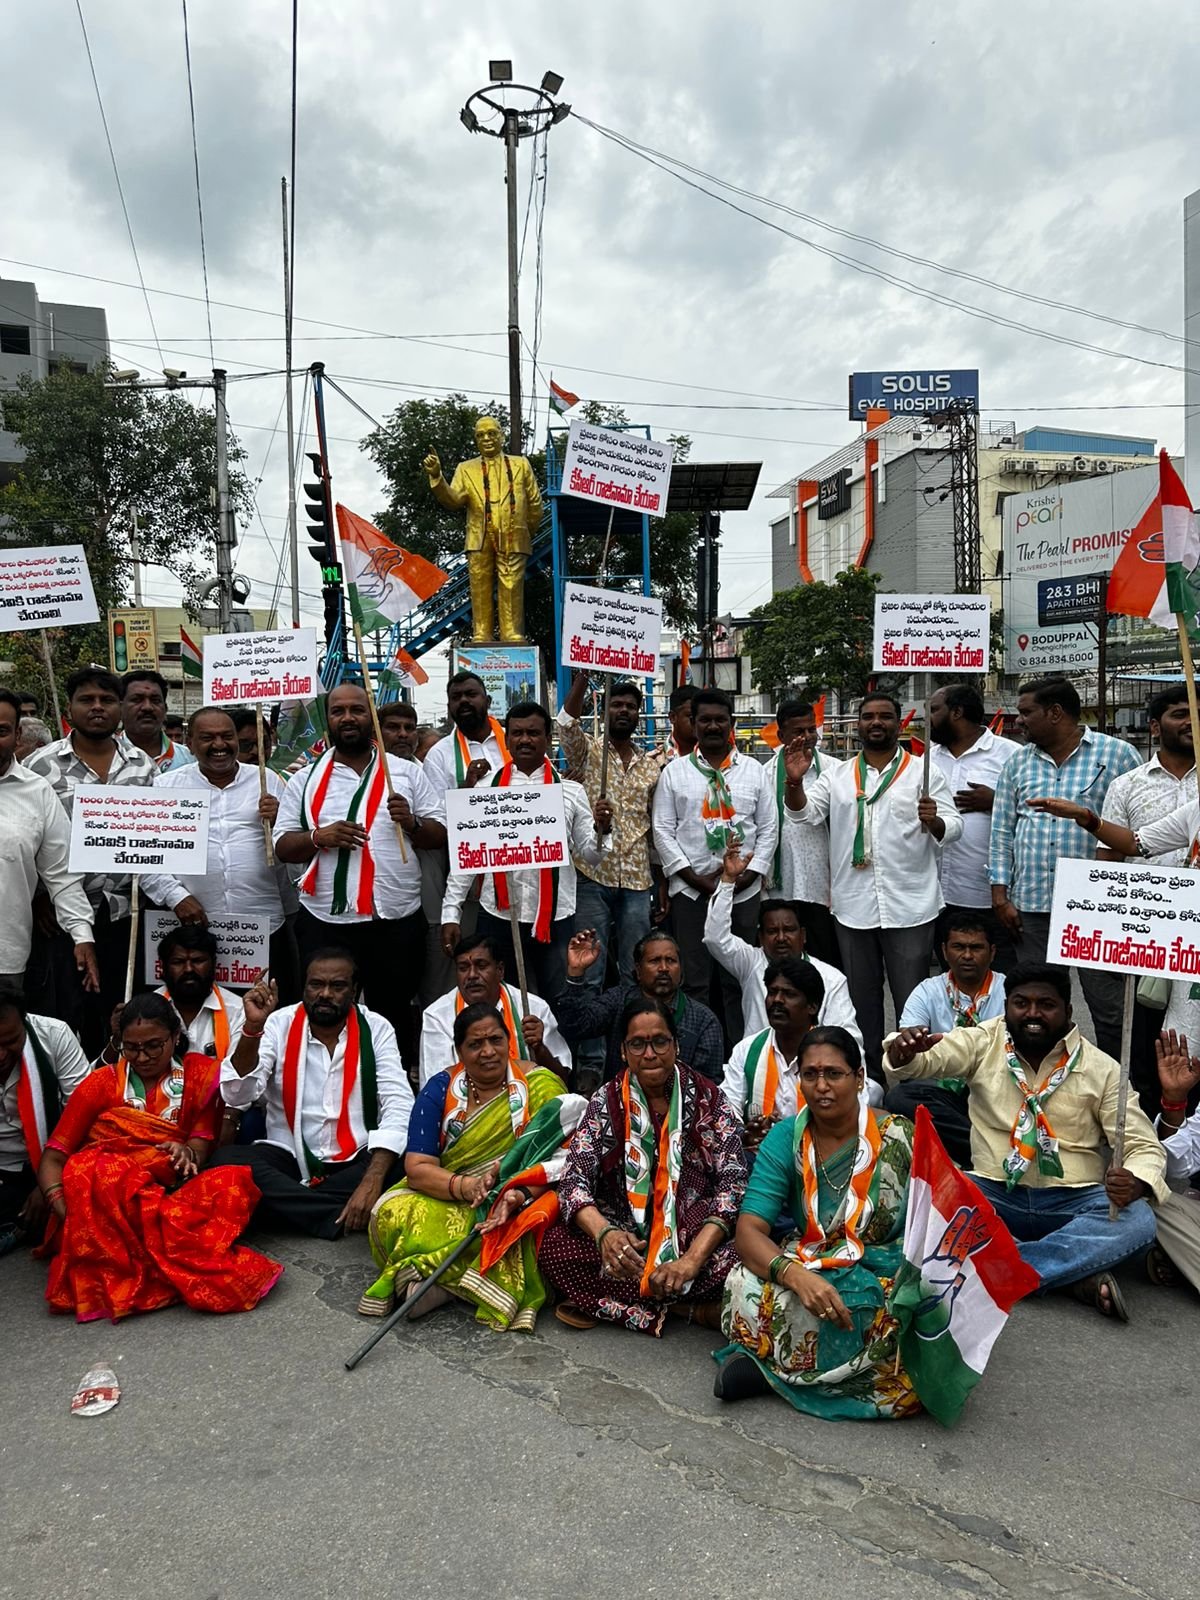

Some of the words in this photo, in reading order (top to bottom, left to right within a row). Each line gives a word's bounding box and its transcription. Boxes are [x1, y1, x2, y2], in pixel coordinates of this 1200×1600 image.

[882, 375, 952, 393] SOLIS
[858, 399, 886, 412] EYE
[579, 428, 598, 440] ప్రజల
[598, 433, 618, 445] కోసం
[571, 440, 596, 457] ప్రతిపక్ష
[577, 454, 609, 470] తెలంగాణ
[637, 470, 656, 482] కోసం
[569, 466, 596, 495] కేసీఆర్
[595, 480, 633, 504] రాజీనామా
[633, 483, 661, 511] చేయాలి
[821, 479, 838, 499] SVK
[1016, 543, 1035, 561] The
[1037, 537, 1070, 559] Pearl
[1072, 528, 1133, 554] PROMIS
[1016, 563, 1047, 573] DELIVERED
[1074, 556, 1093, 565] EVERY
[1095, 553, 1109, 561] TIME
[25, 592, 83, 606] రాజీనామా
[1046, 585, 1072, 599] 2&3
[603, 598, 639, 613] రాజకీయాలు
[881, 601, 899, 613] ప్రజల
[933, 601, 948, 613] కోట్ల
[948, 602, 987, 611] రూపాయల
[1046, 595, 1100, 609] APARTMENT
[17, 608, 62, 621] చేయాలి!
[593, 611, 607, 621] ప్రజా
[606, 626, 626, 640] ప్రతిపక్ష
[883, 629, 902, 639] ప్రజల
[903, 627, 923, 638] కోసం
[923, 629, 945, 641] శూన్య
[1031, 631, 1089, 645] BODUPPAL
[226, 637, 253, 648] ప్రతిపక్ష
[253, 635, 277, 644] హోదా
[278, 635, 295, 644] ప్రజా
[239, 648, 253, 656] సేవ
[570, 635, 595, 664] కేసీఆర్
[595, 645, 630, 669] రాజీనామా
[631, 645, 655, 673] చేయాలి
[882, 641, 910, 666] కేసీఆర్
[911, 645, 952, 667] రాజీనామా
[954, 642, 984, 667] చేయాలి
[1029, 656, 1047, 665] 834
[1048, 654, 1068, 664] 834
[1069, 652, 1094, 662] 6000
[254, 657, 285, 666] విశ్రాంతి
[286, 654, 308, 662] కోసం
[250, 668, 270, 676] కాదు
[211, 677, 239, 701] కేసీఆర్
[240, 677, 280, 699] రాజీనామా
[282, 672, 312, 696] చేయాలి
[469, 795, 498, 805] ప్రతిపక్ష
[498, 792, 523, 801] హోదా
[524, 791, 541, 802] ప్రజా
[82, 809, 101, 818] ప్రజల
[103, 810, 122, 820] మధ్య
[172, 811, 196, 820] కేసీఆర్
[484, 806, 499, 815] సేవ
[84, 821, 109, 829] కేసీఆర్
[502, 817, 533, 828] విశ్రాంతి
[535, 815, 557, 824] కోసం
[498, 831, 519, 840] కాదు
[84, 836, 126, 848] పదవికి
[129, 838, 195, 850] రాజీనామా
[113, 851, 164, 865] చేయాలి!
[457, 841, 488, 869] కేసీఆర్
[488, 842, 532, 866] రాజీనామా
[533, 835, 564, 863] చేయాలి
[1088, 869, 1129, 886] ప్రతిపక్ష
[1129, 872, 1166, 885] హోదా
[1168, 876, 1195, 889] ప్రజా
[1107, 886, 1127, 898] సేవ
[1130, 888, 1172, 903] కోసం...
[1066, 899, 1095, 911] ఫామ్
[1097, 902, 1127, 915] హౌస్
[1130, 906, 1176, 920] విశ్రాంతి
[1121, 922, 1150, 934] కాదు
[232, 946, 254, 956] కోసం
[1060, 924, 1102, 961] కేసీఆర్
[1102, 937, 1166, 970] రాజీనామా
